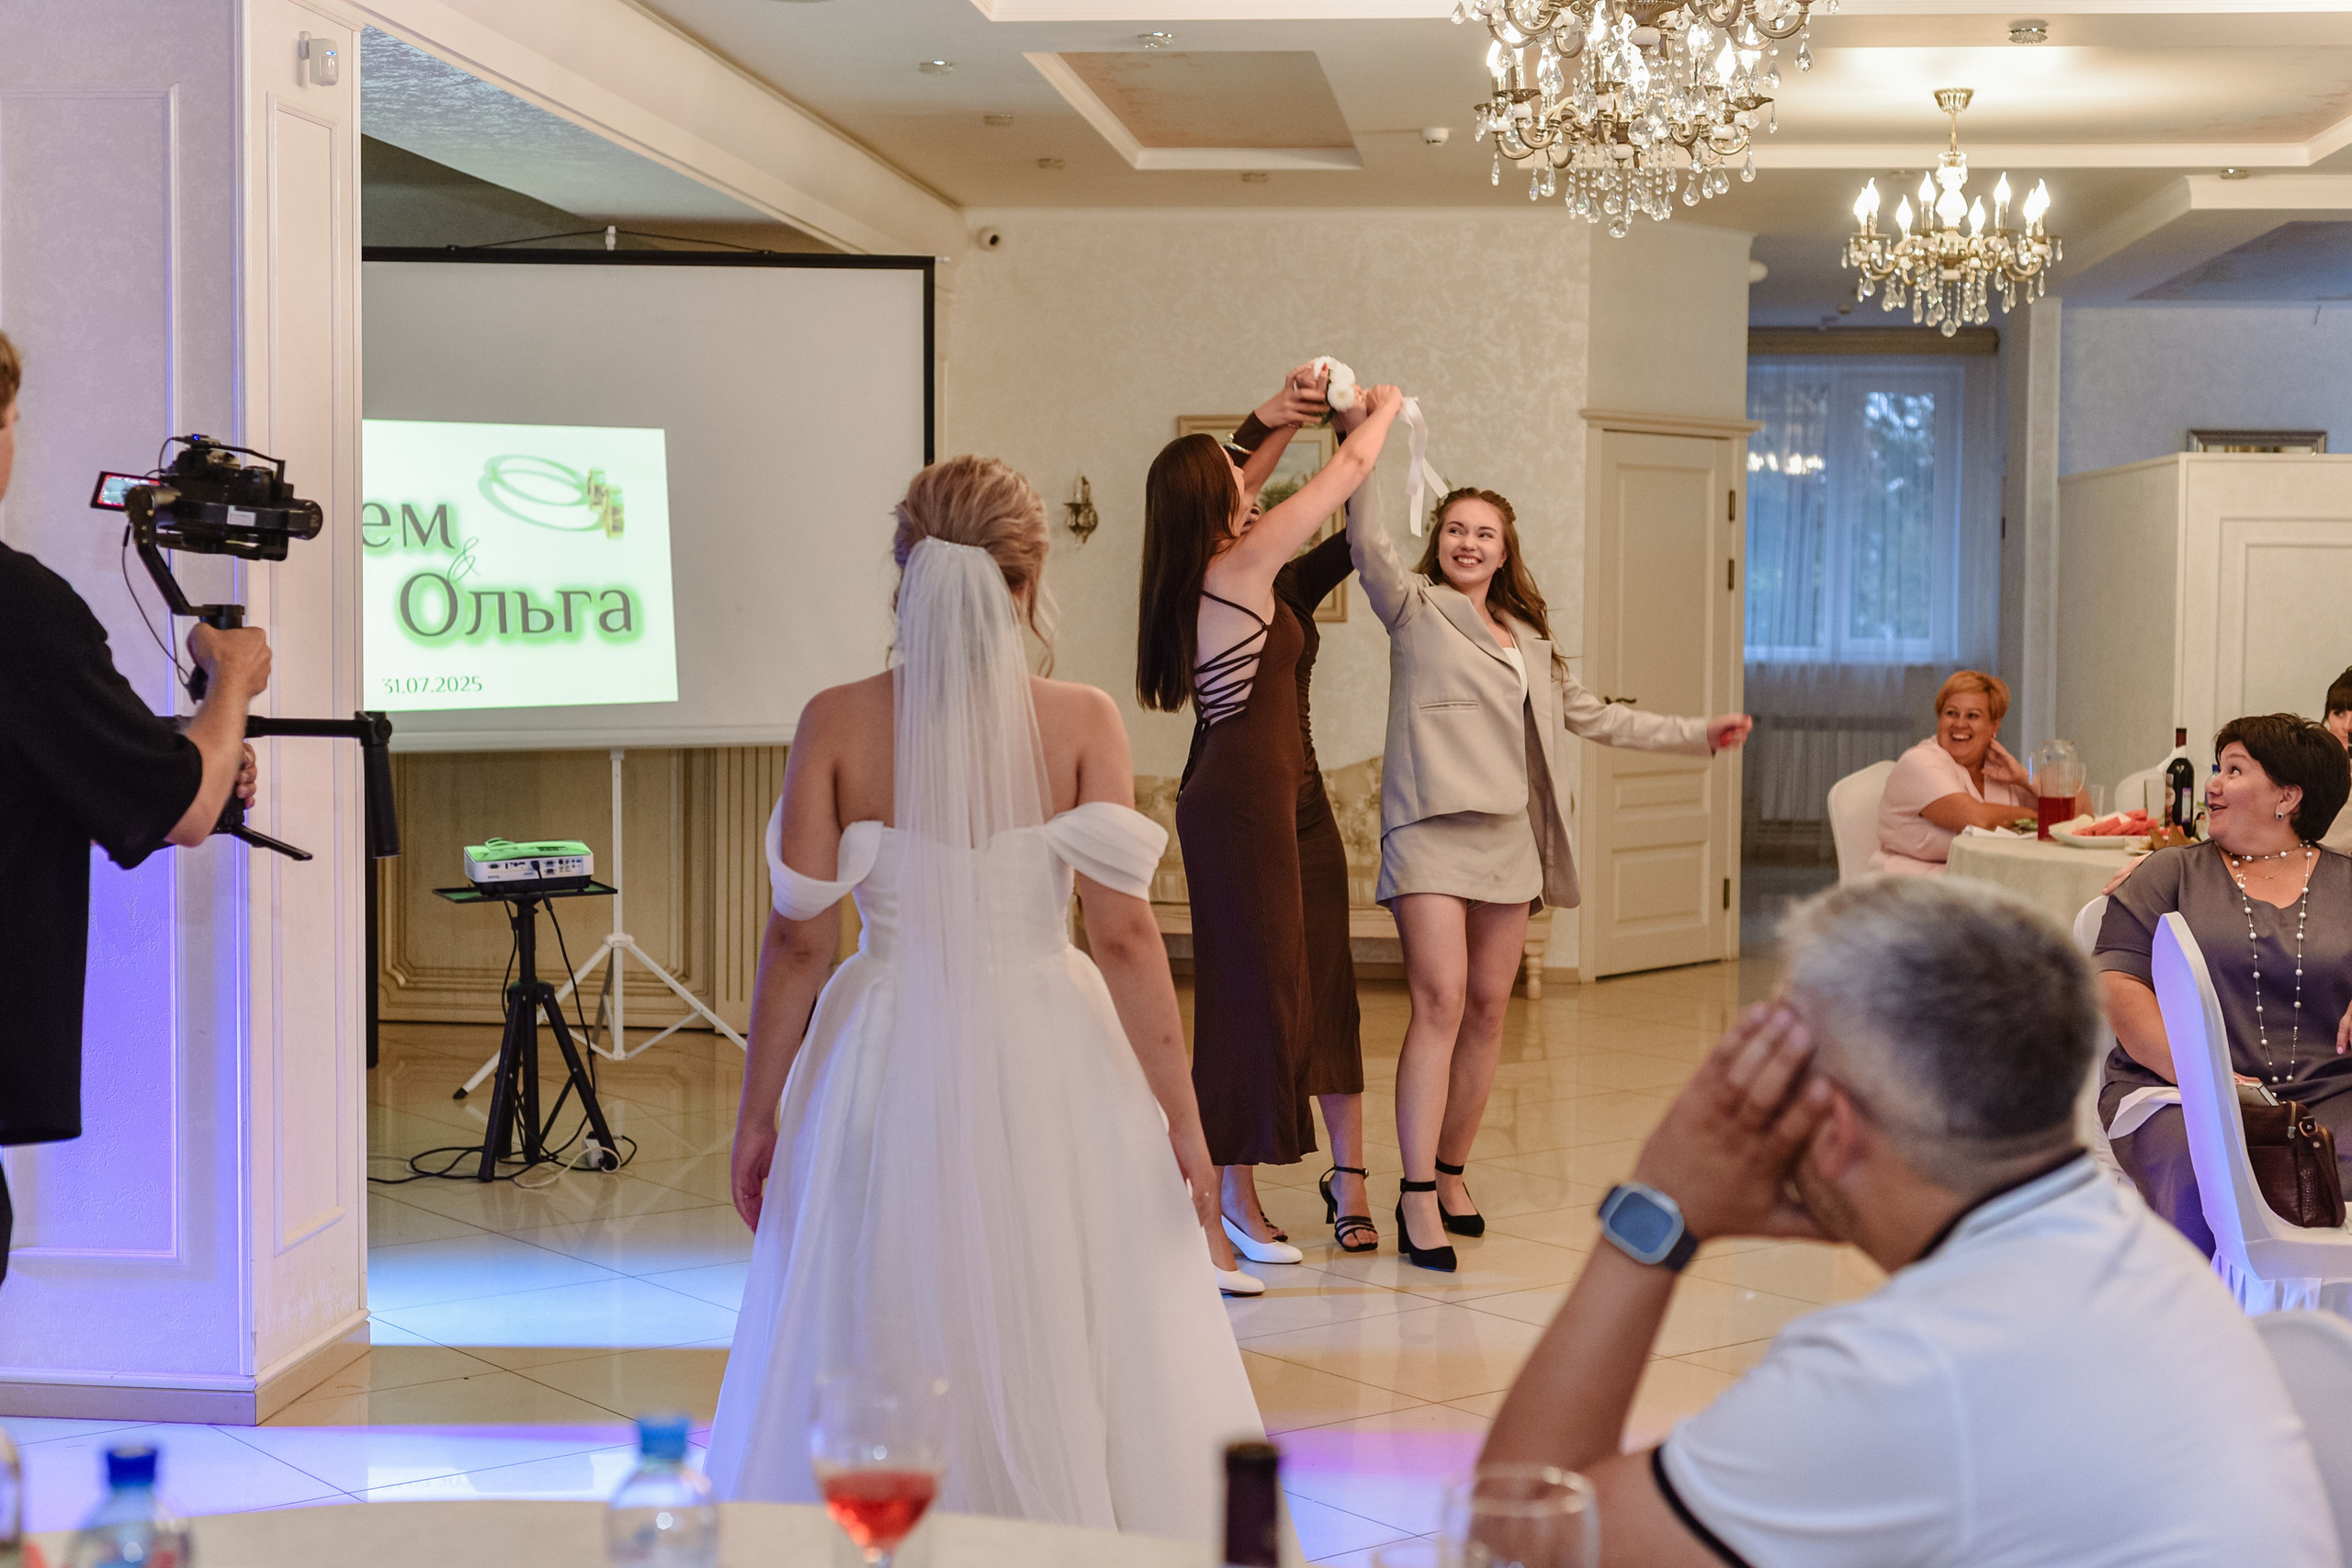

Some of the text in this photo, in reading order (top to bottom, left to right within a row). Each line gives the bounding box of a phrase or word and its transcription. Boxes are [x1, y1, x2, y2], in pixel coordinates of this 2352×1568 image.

[363, 502, 456, 549] ем
[399, 572, 632, 637] Ольга
[381, 675, 483, 694] 31.07.2025
